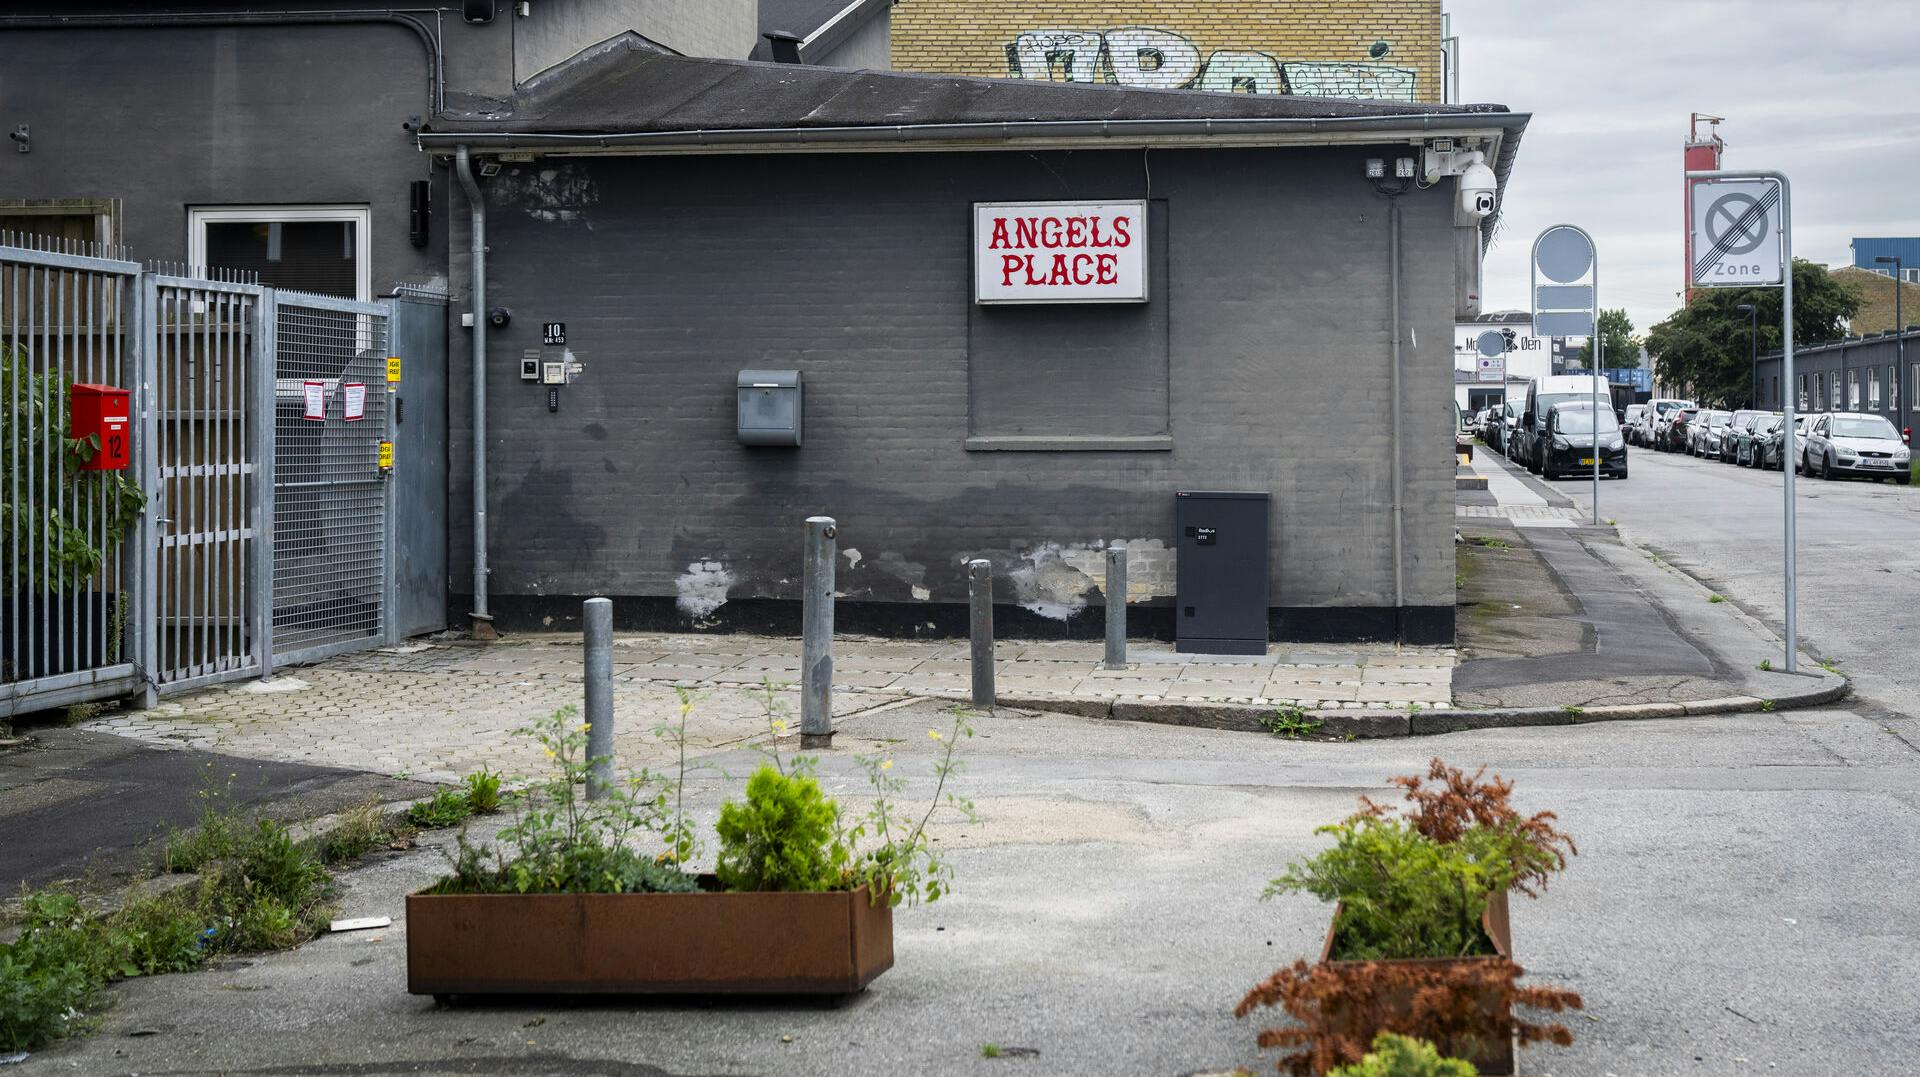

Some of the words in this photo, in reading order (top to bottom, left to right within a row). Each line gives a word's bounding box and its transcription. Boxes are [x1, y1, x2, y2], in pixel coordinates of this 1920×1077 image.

[988, 216, 1131, 249] ANGELS
[1001, 254, 1119, 286] PLACE
[1714, 262, 1761, 276] Zone
[548, 323, 561, 338] 10
[1521, 336, 1542, 351] Øen
[109, 434, 122, 459] 12
